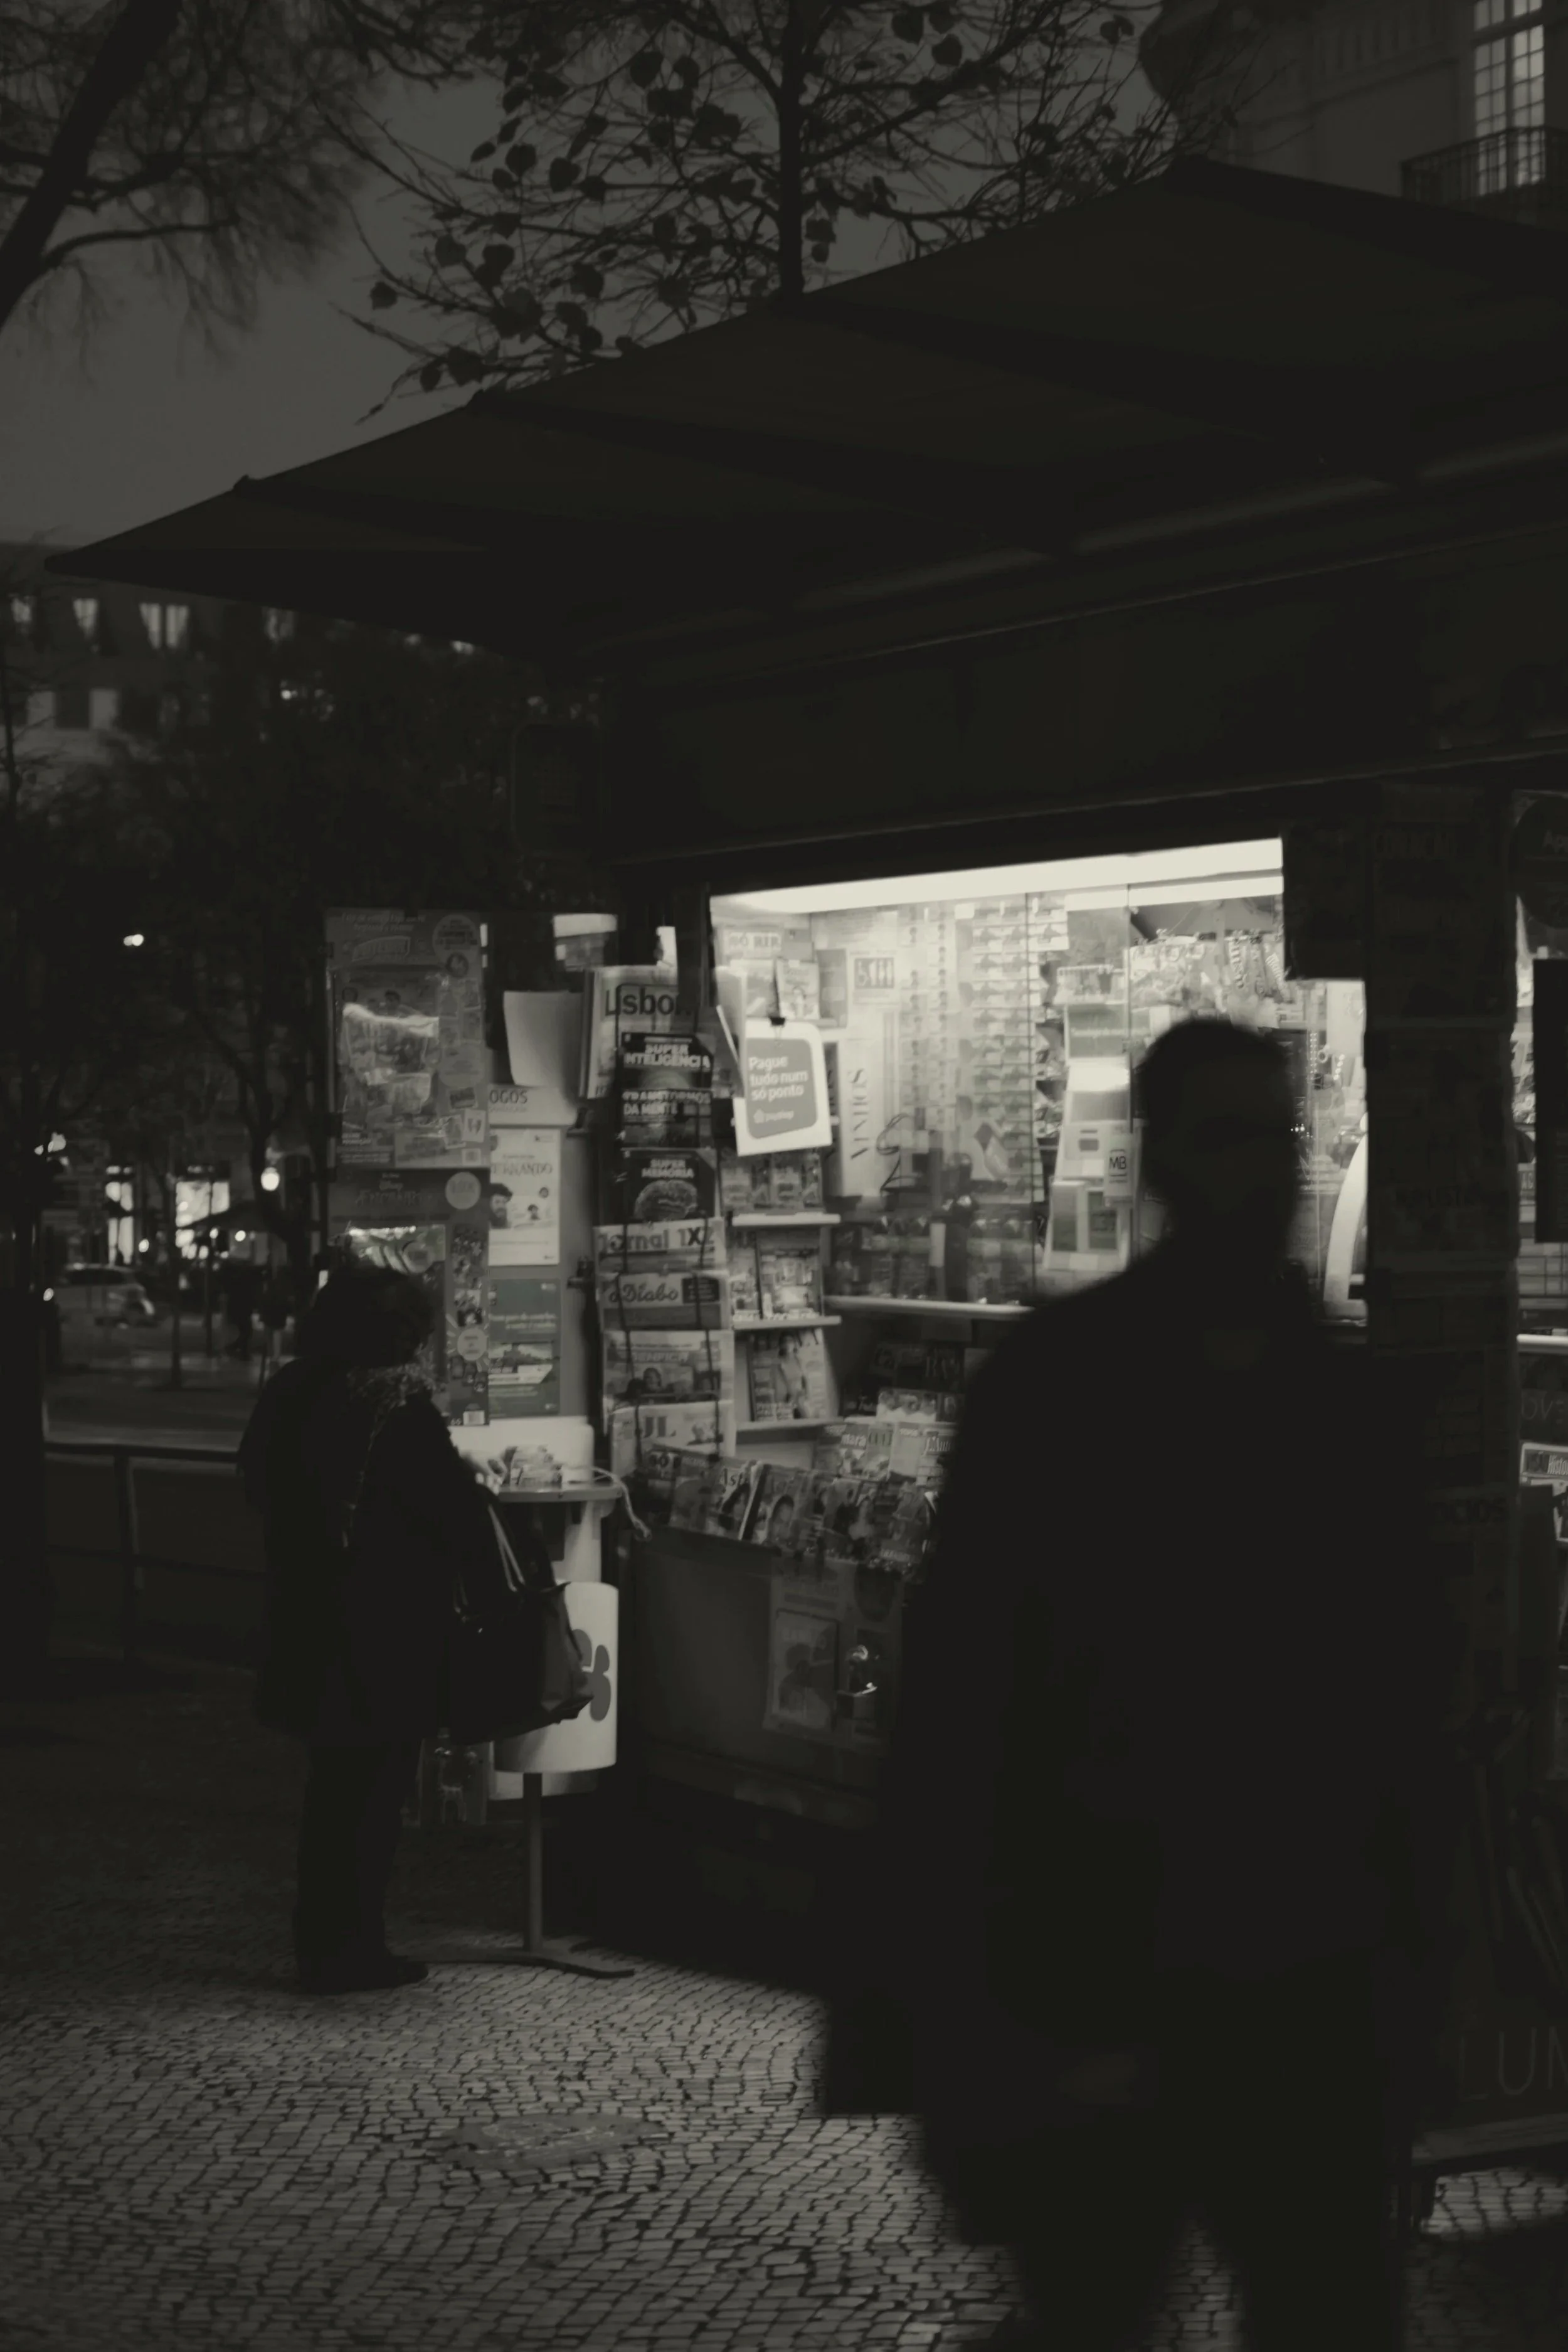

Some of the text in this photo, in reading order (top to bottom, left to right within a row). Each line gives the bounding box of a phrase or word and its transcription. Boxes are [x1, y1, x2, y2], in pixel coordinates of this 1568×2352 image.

[748, 1056, 788, 1072] Pague
[750, 1070, 808, 1087] tudo num
[751, 1084, 805, 1103] só ponto
[1110, 1157, 1127, 1170] MB
